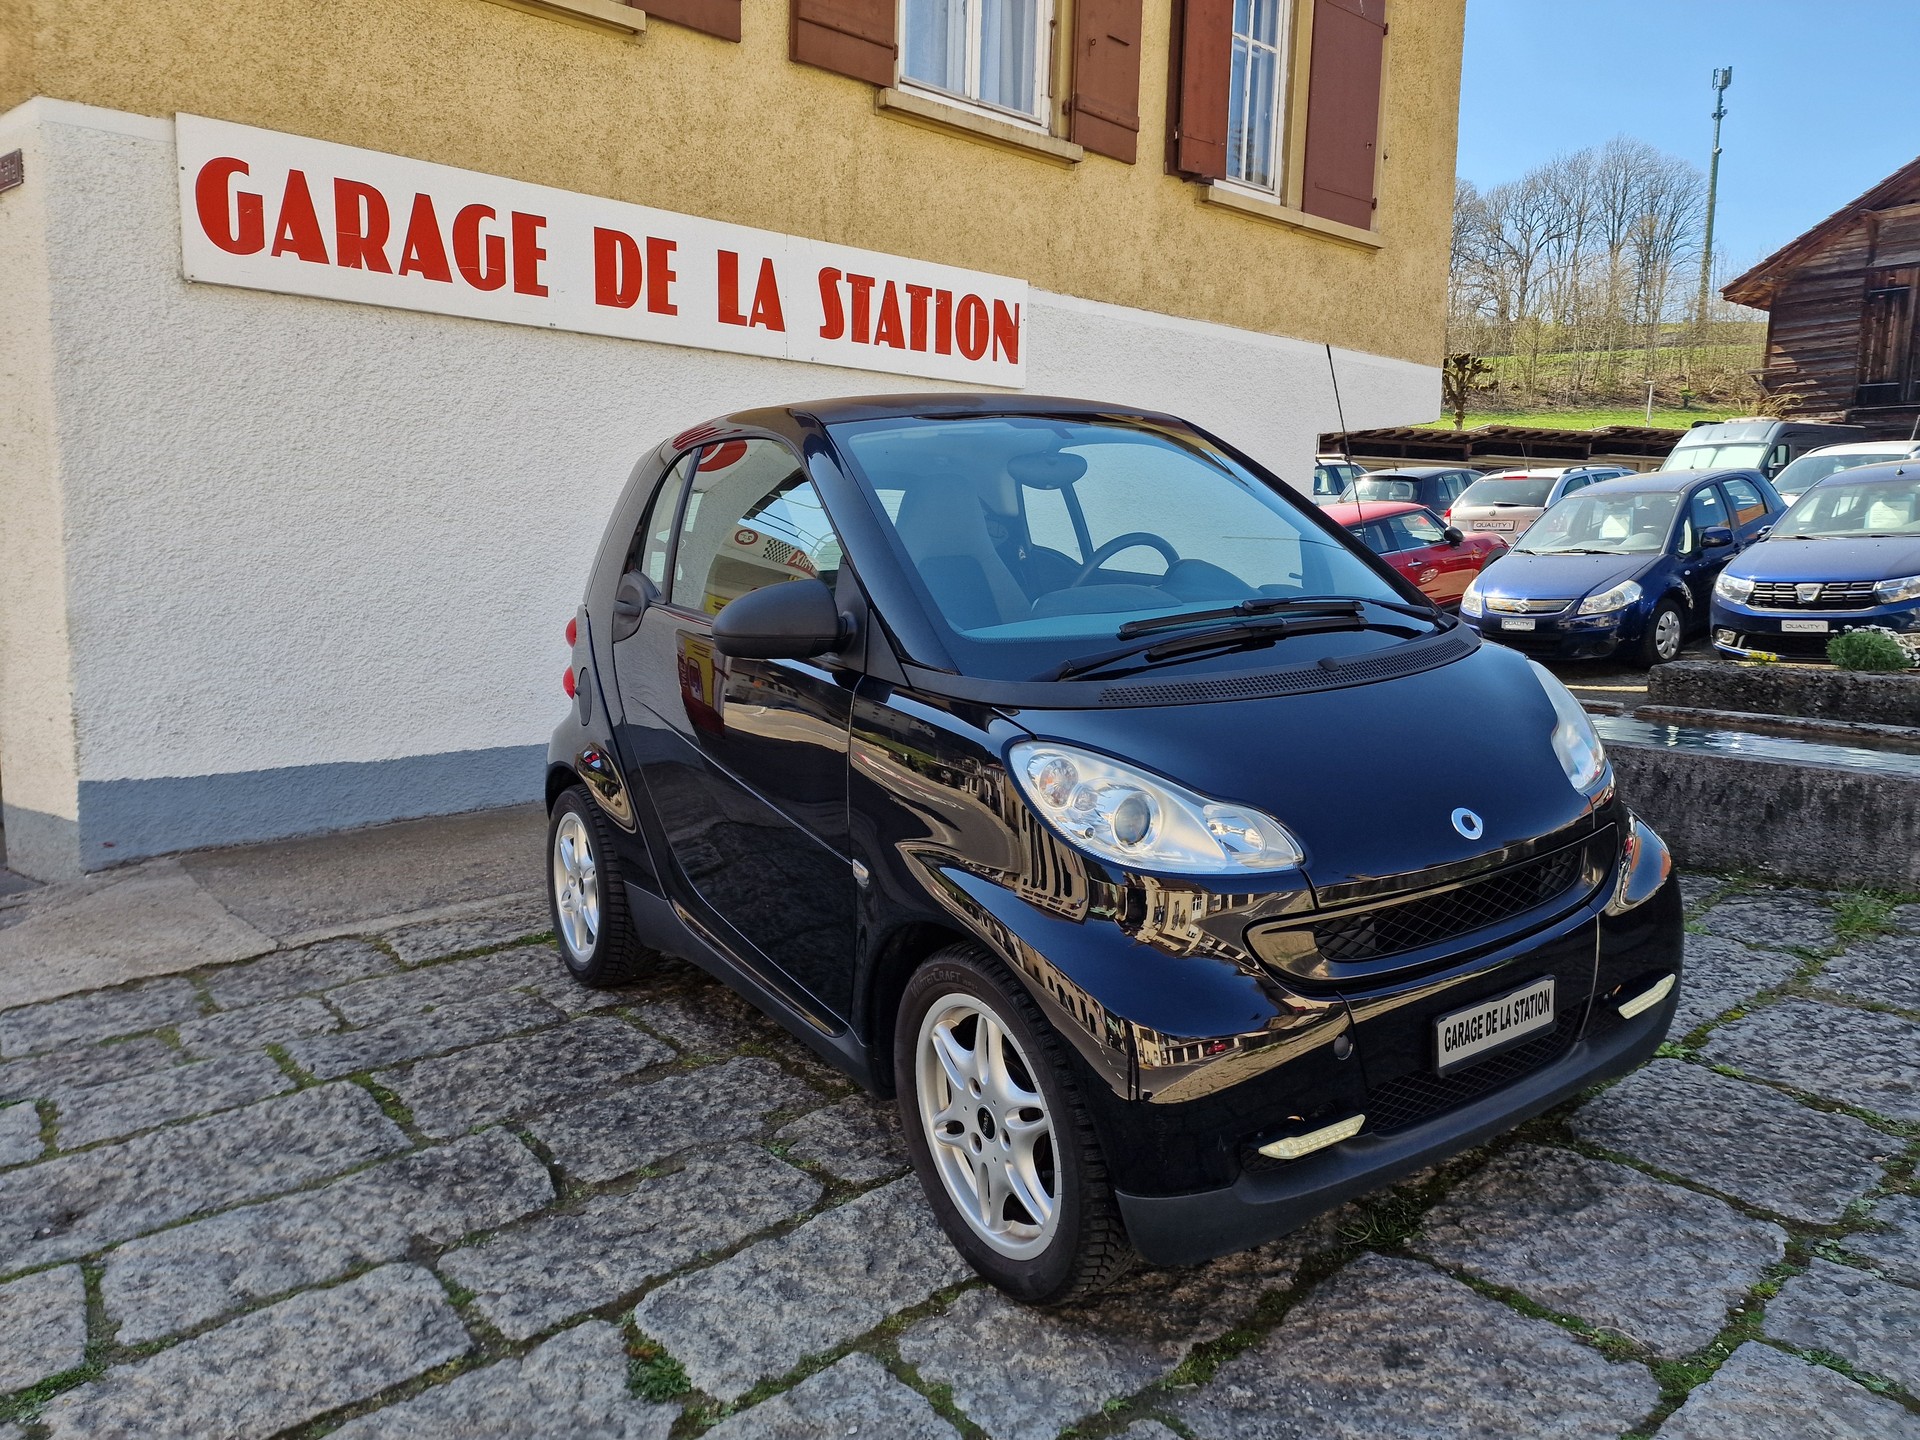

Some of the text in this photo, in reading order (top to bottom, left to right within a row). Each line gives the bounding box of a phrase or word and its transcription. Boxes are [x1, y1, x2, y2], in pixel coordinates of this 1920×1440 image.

[195, 156, 1020, 365] GARAGE DE LA STATION
[1444, 988, 1550, 1053] GARAGE DE LA STATION
